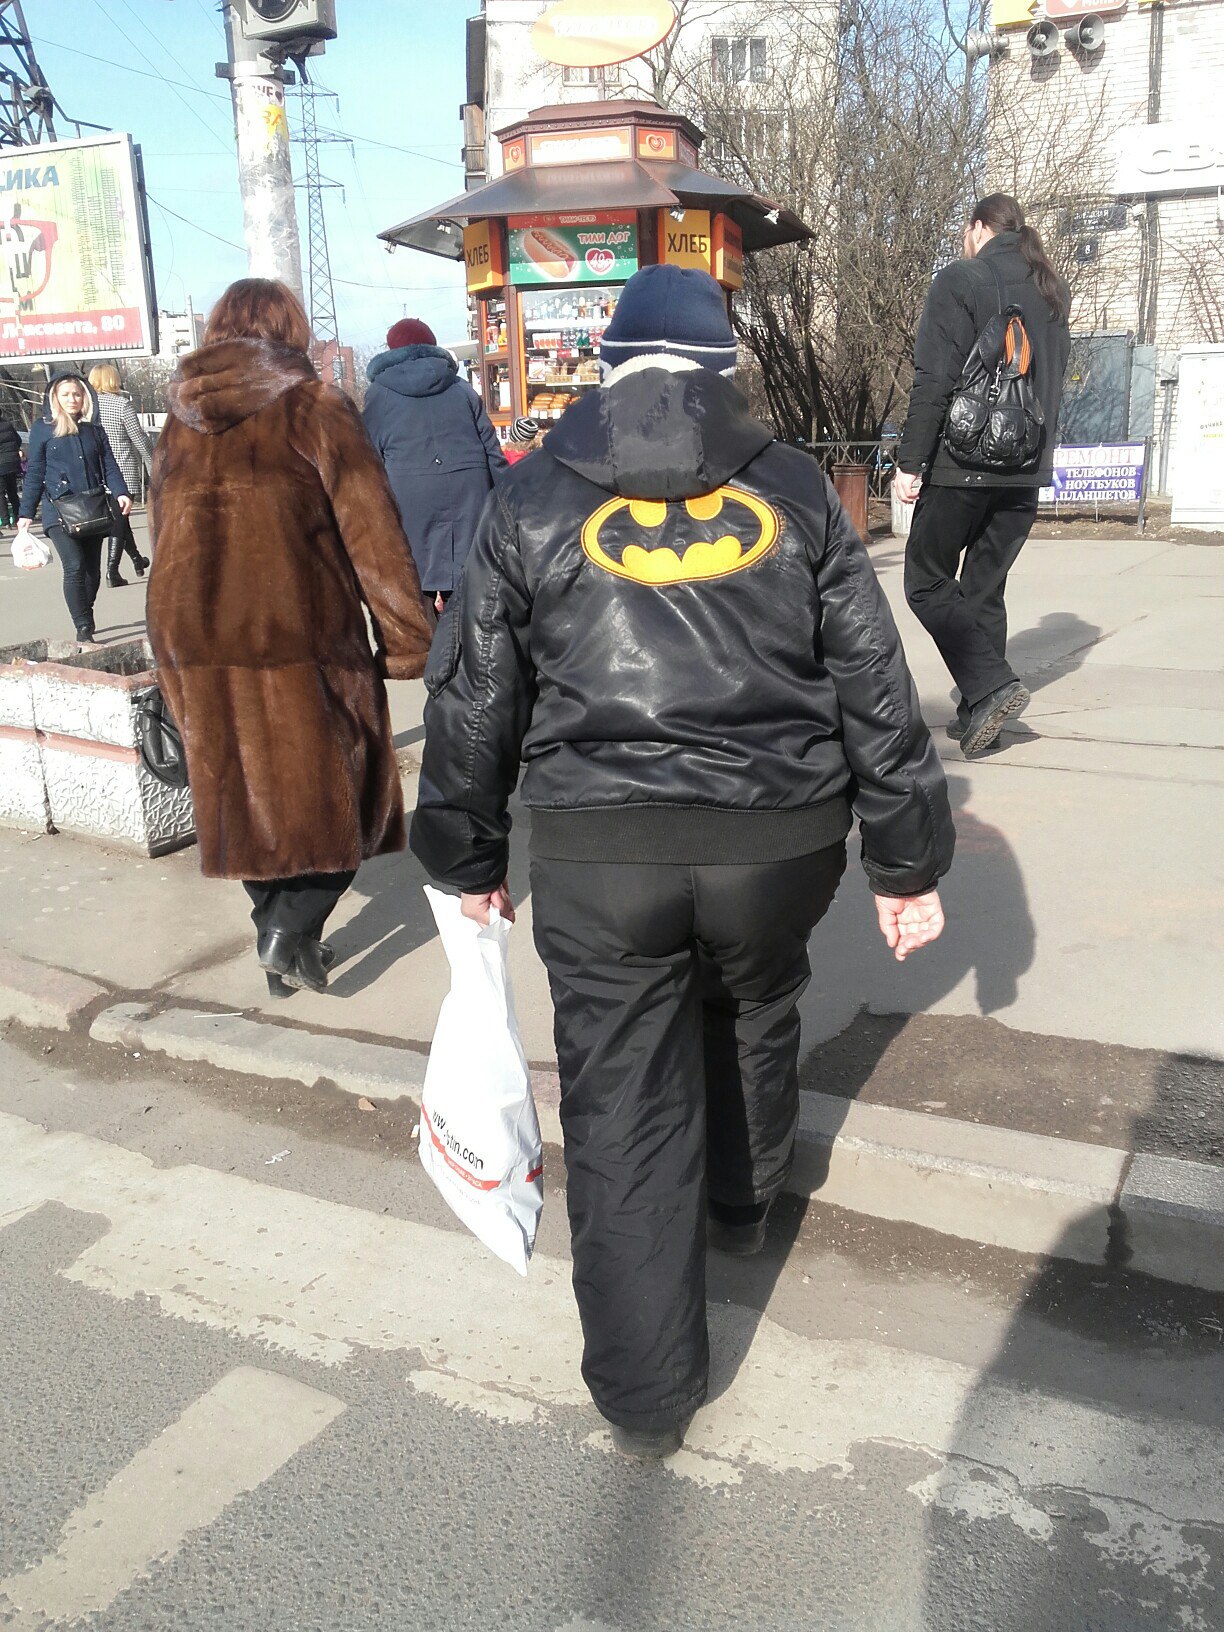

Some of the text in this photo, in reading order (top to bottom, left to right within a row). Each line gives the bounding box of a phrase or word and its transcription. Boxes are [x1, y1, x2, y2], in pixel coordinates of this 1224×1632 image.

[0, 165, 60, 192] ИКА
[577, 231, 631, 245] ТИЛИ ДОГ
[667, 232, 707, 253] ХЛЕБ
[466, 243, 490, 268] ХЛЕБ
[1055, 448, 1136, 465] РЕМОНТ
[1065, 467, 1137, 478] ТЕЛЕФОНОВ
[1065, 479, 1136, 490] НОУТБУКОВ
